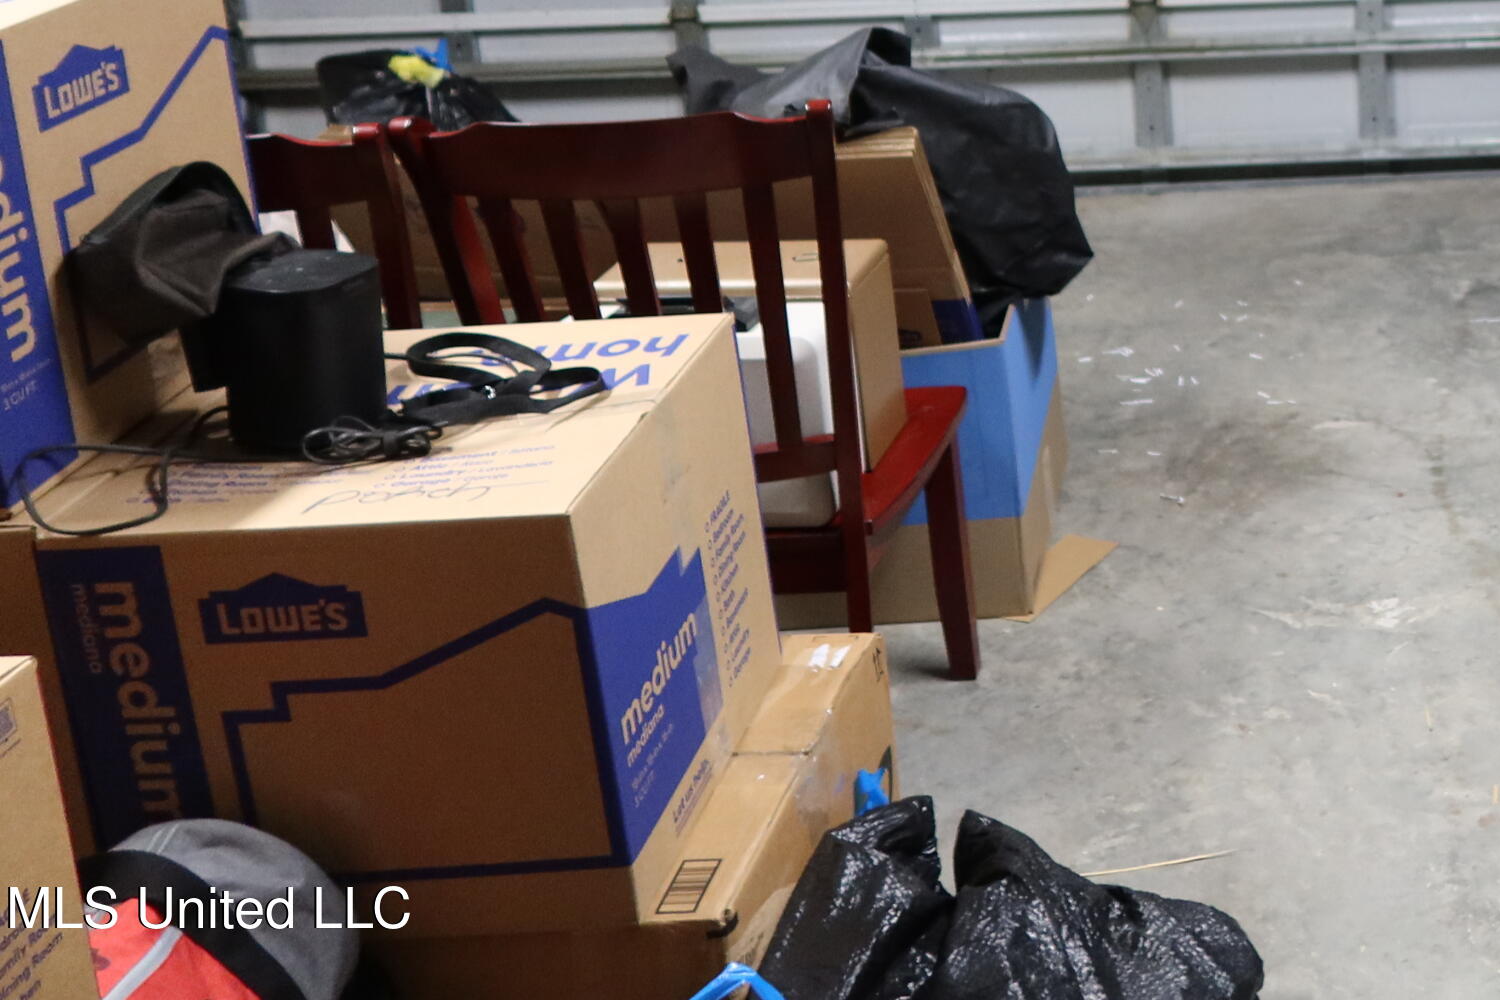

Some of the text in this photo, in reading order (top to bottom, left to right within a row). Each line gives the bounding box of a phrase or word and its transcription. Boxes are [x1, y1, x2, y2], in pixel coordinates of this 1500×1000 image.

[43, 61, 121, 119] LOWE'S
[216, 599, 349, 635] LOWE'S
[620, 612, 697, 746] medium
[627, 704, 665, 768] mediana
